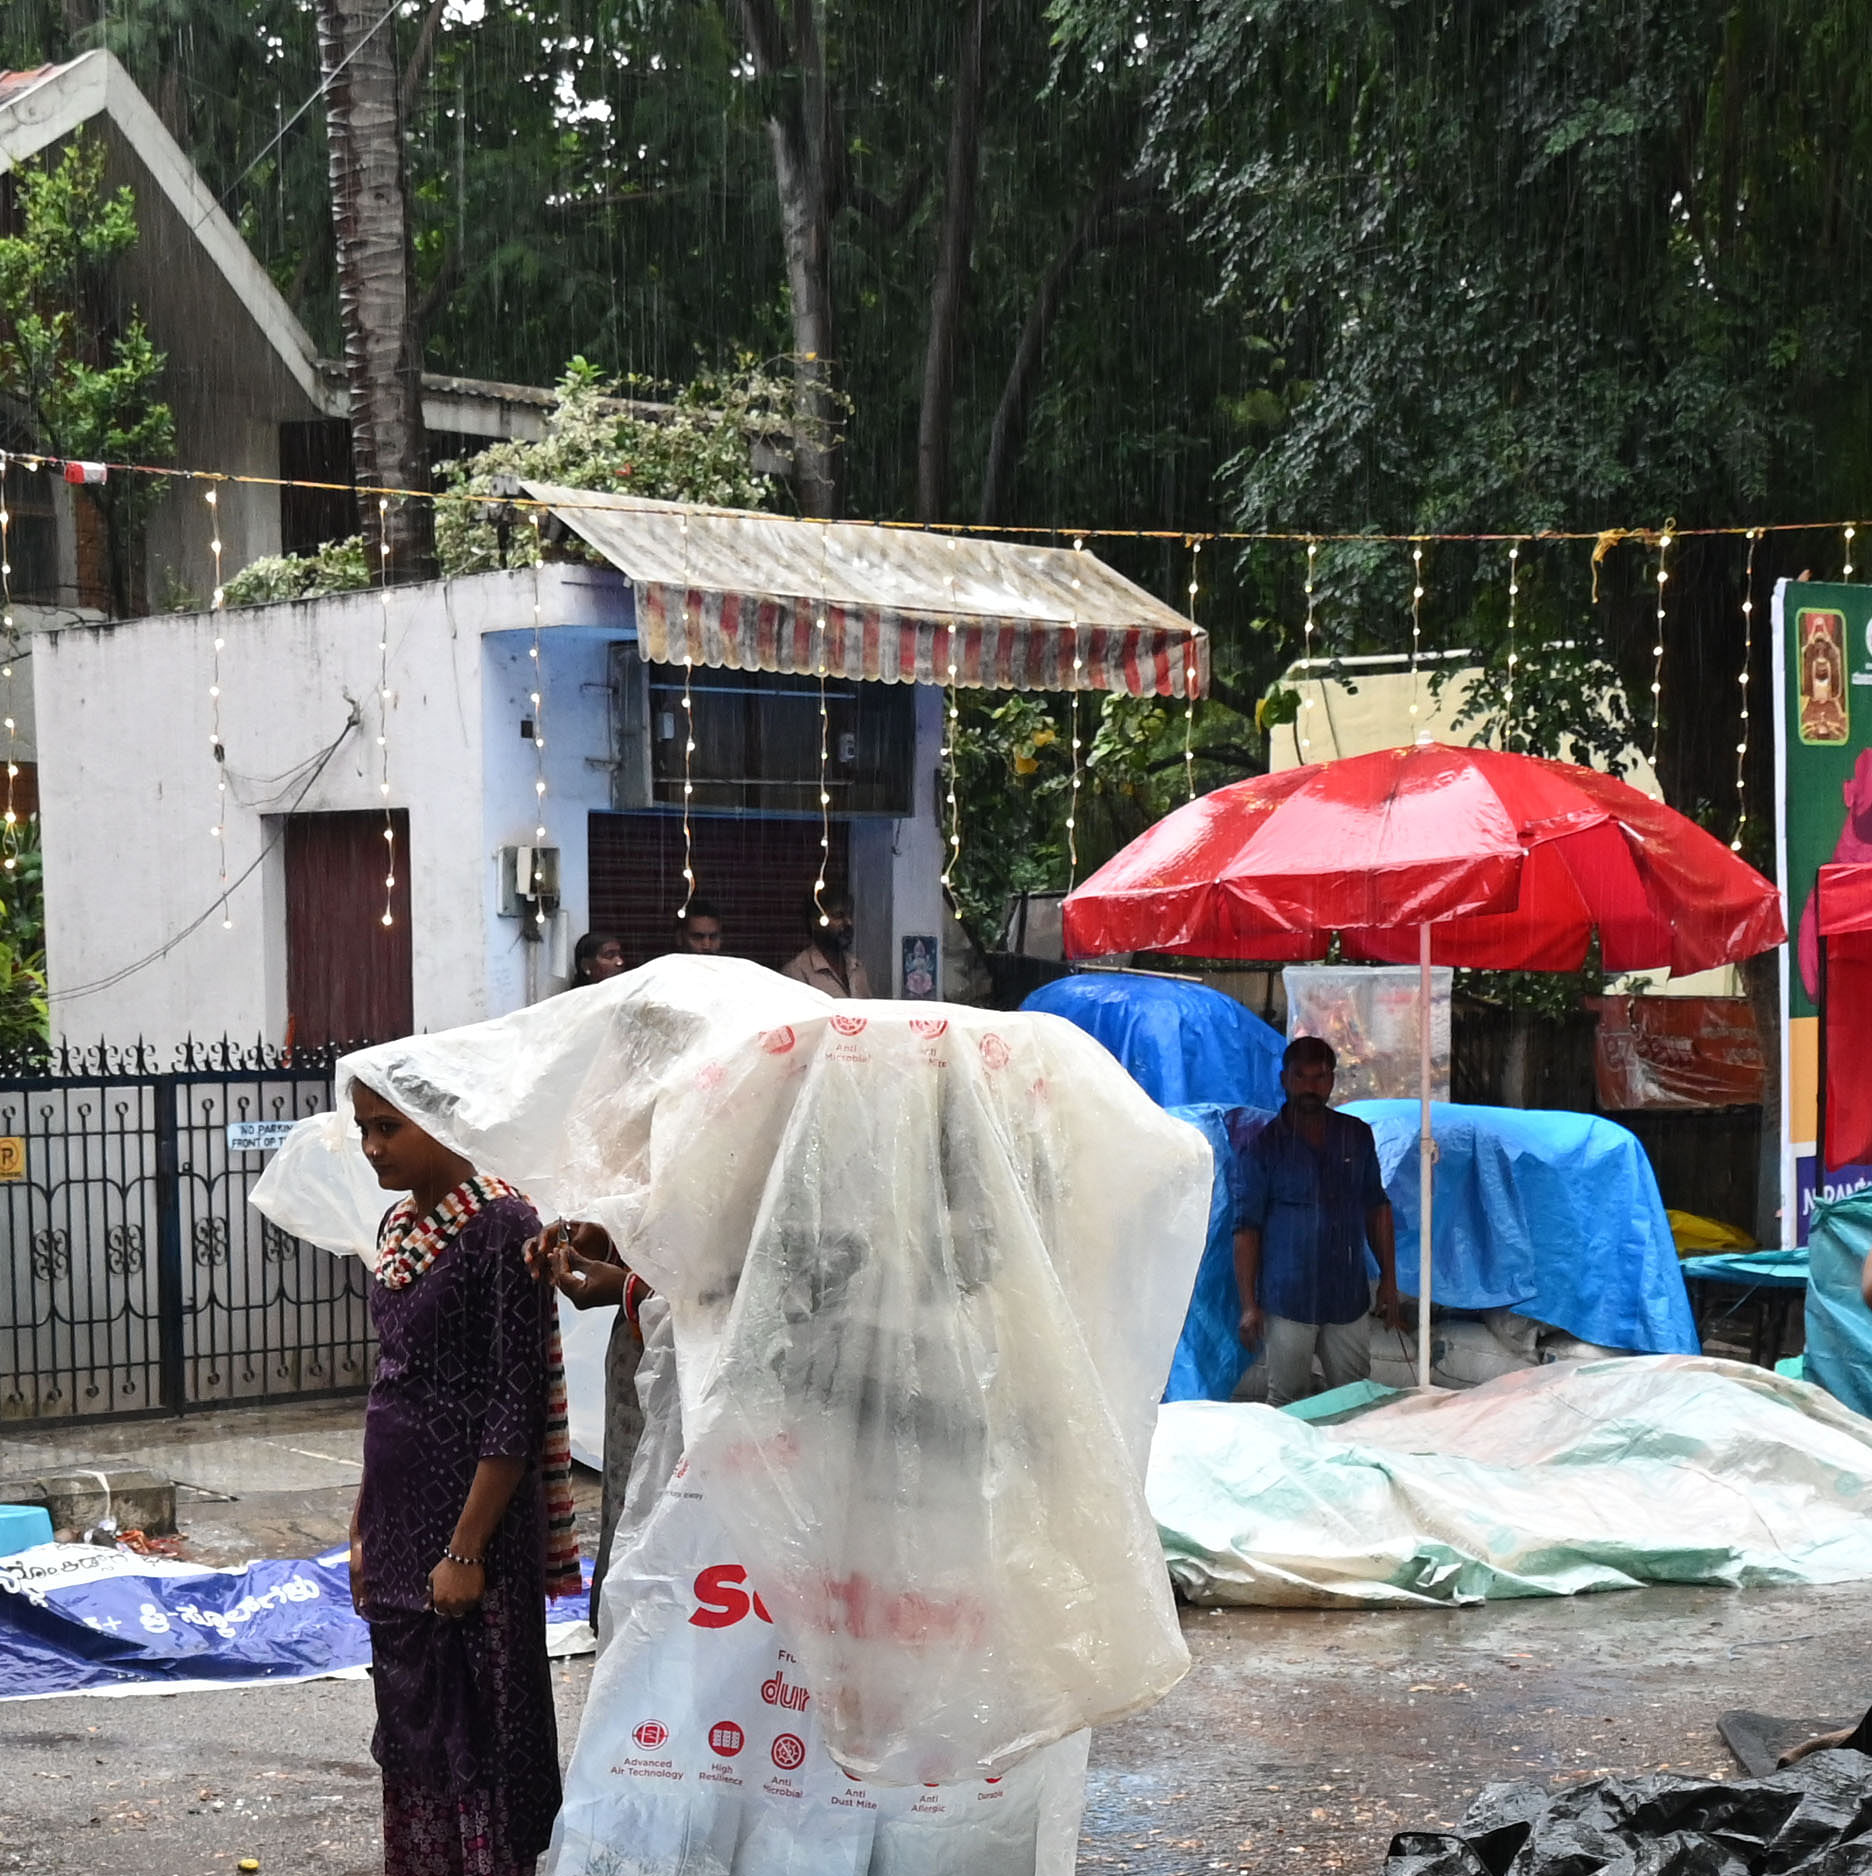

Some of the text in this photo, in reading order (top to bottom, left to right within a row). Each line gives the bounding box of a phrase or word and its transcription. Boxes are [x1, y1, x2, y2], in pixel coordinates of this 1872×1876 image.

[240, 1123, 294, 1137] NO PARKIN
[232, 1137, 261, 1149] FRONT
[624, 1757, 672, 1769] Advanced
[711, 1763, 733, 1775] High
[610, 1766, 684, 1781] Air Technology
[699, 1772, 744, 1787] Resilience
[771, 1776, 792, 1787] Anti
[845, 1788, 866, 1798] Anti
[919, 1794, 938, 1804] Anti
[831, 1796, 878, 1810] Dust Mite
[911, 1804, 947, 1814] Allergic
